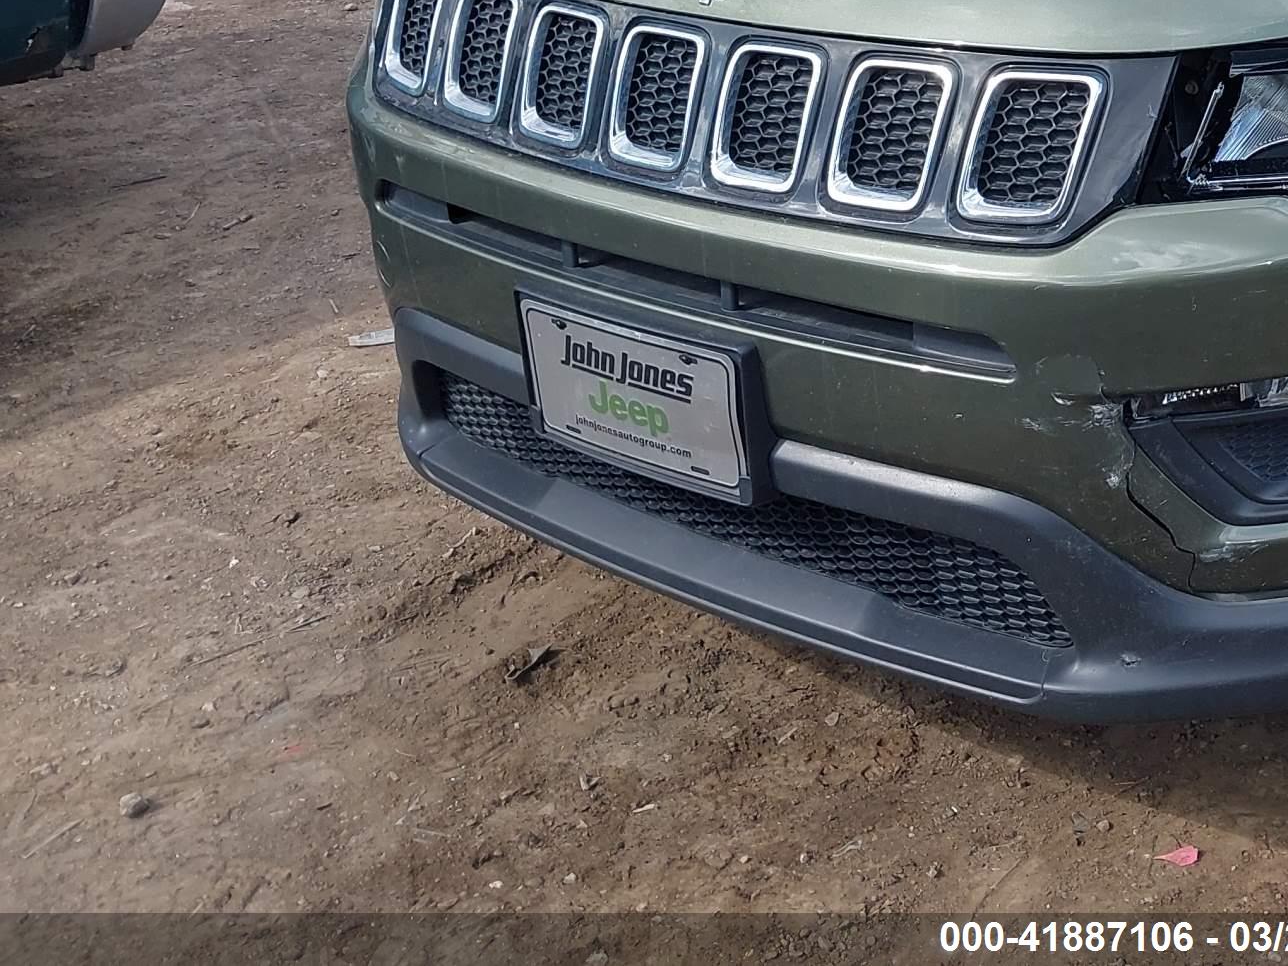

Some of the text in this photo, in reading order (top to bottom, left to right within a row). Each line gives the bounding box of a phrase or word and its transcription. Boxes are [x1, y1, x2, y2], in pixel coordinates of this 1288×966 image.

[561, 335, 694, 397] John Jones
[575, 414, 692, 458] johnjonesautogroup.com
[588, 381, 669, 437] Jeep
